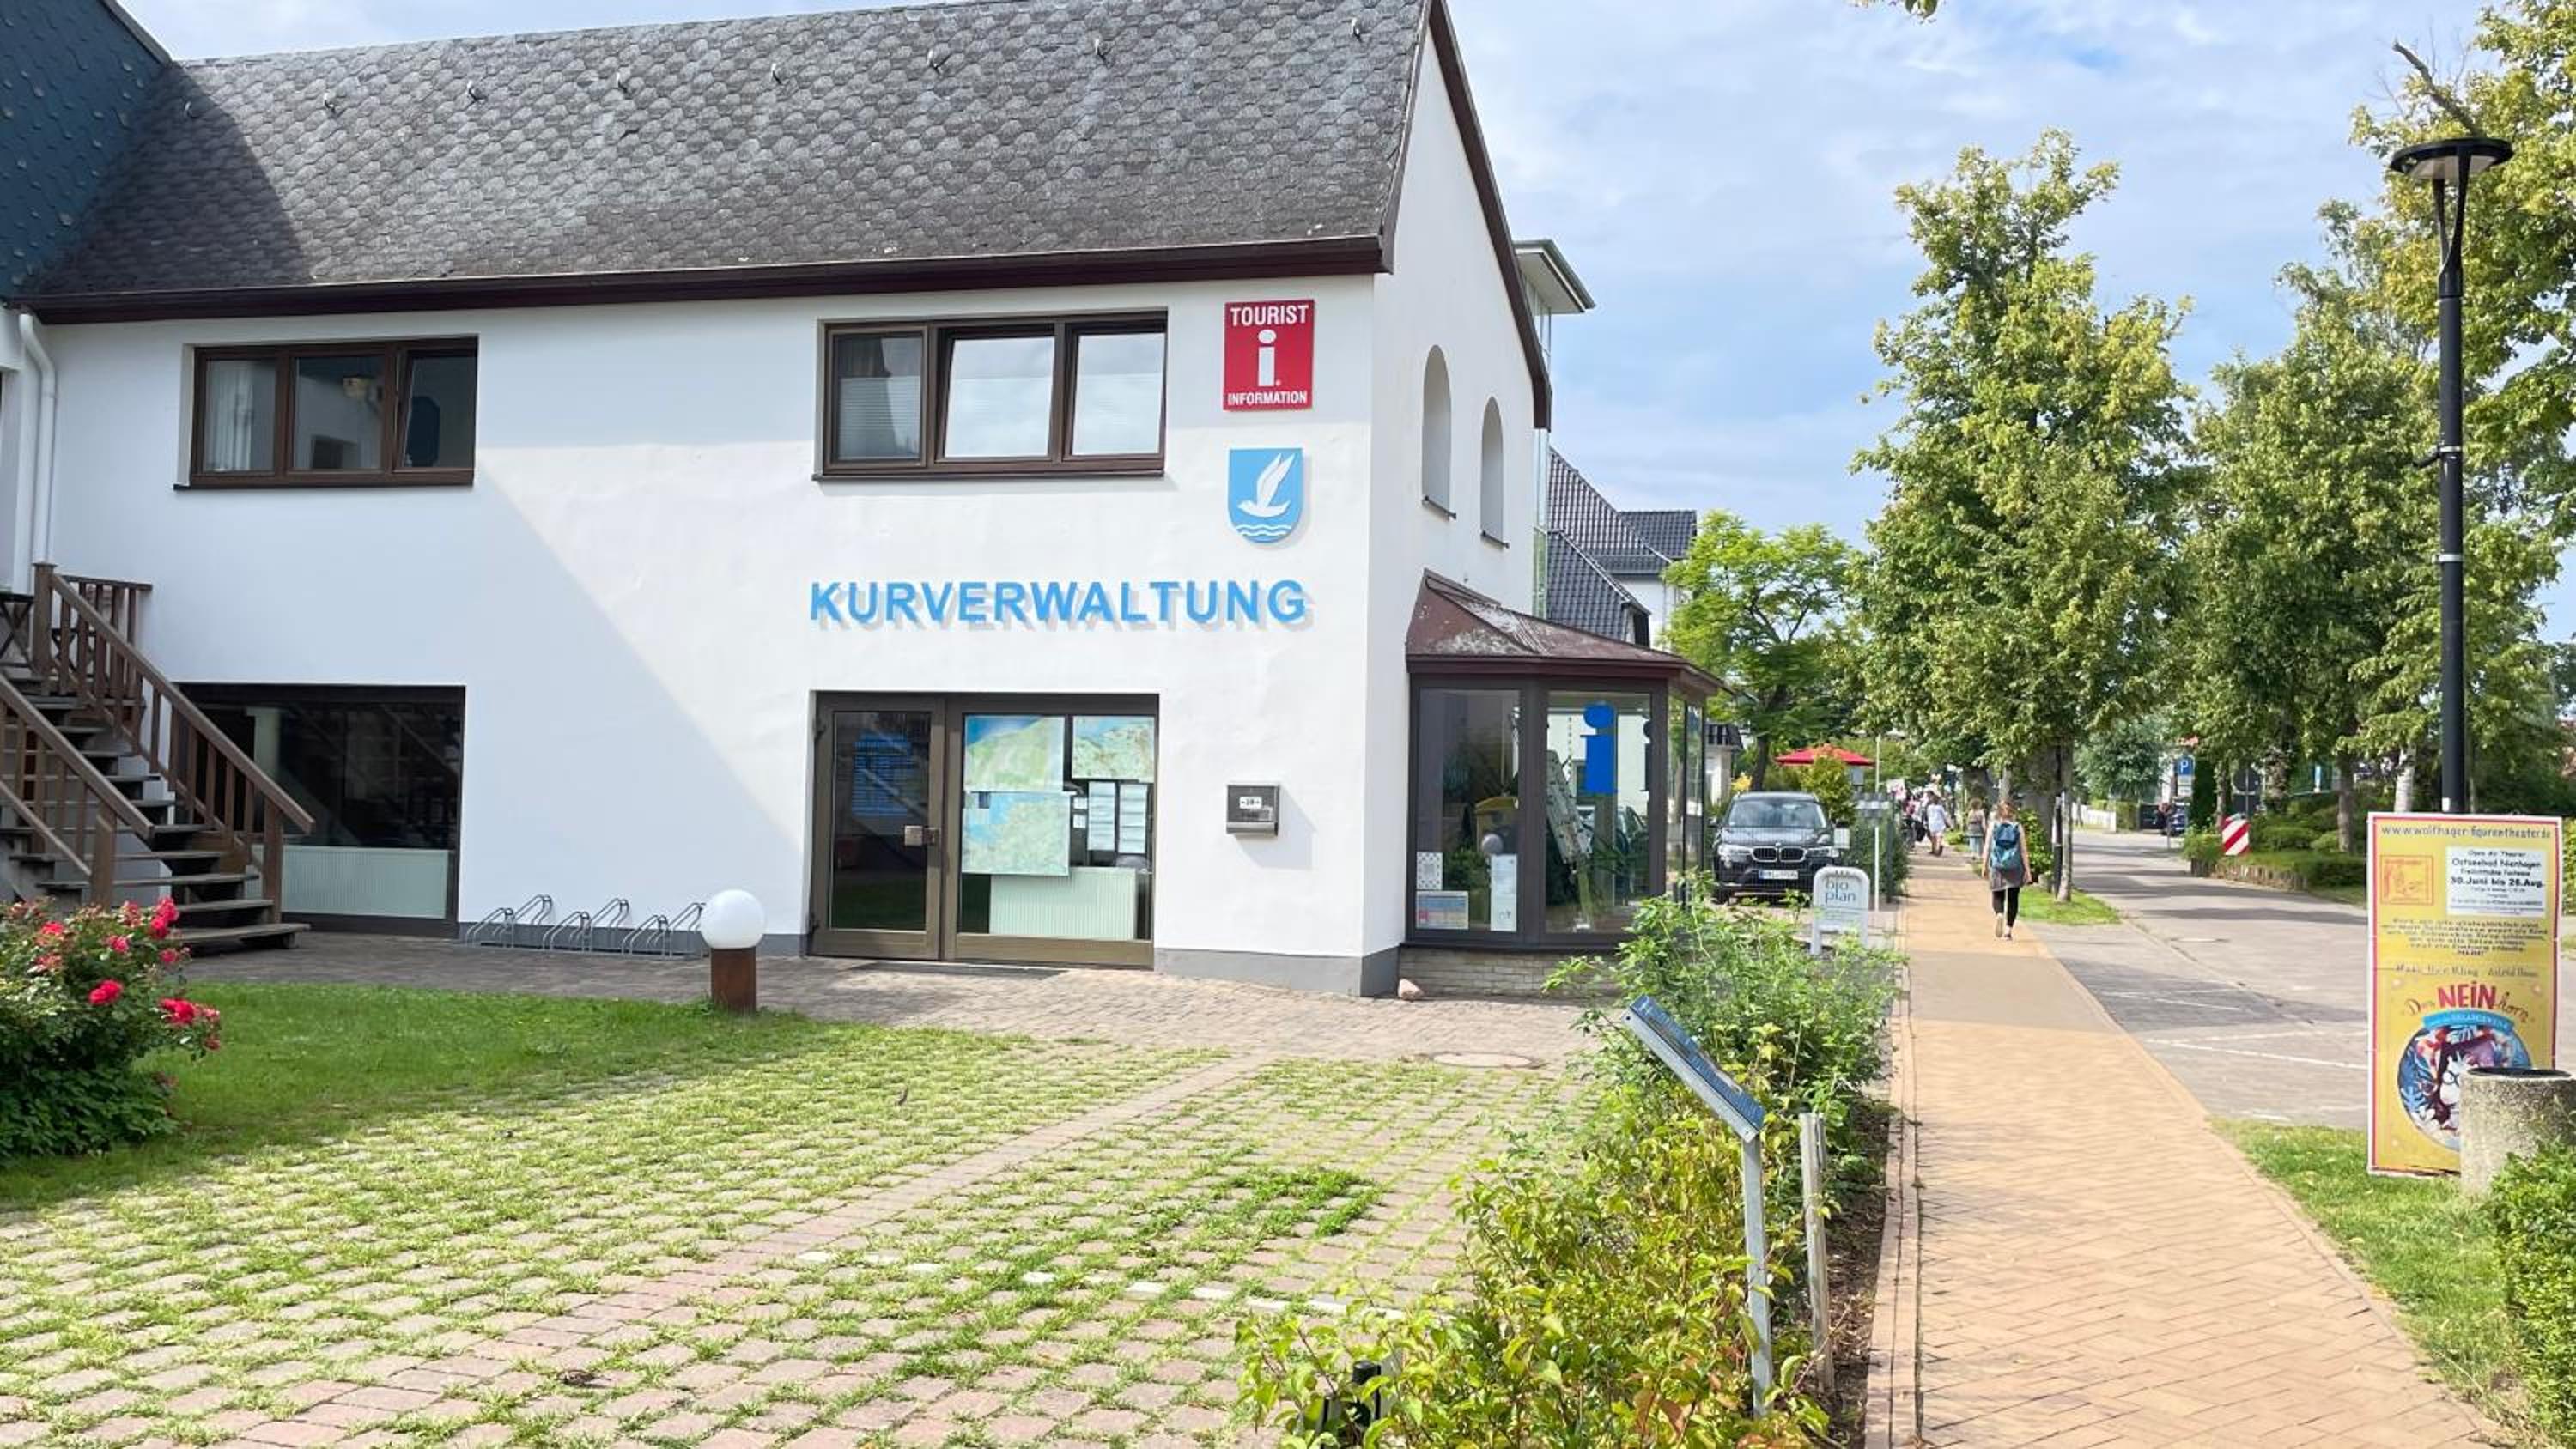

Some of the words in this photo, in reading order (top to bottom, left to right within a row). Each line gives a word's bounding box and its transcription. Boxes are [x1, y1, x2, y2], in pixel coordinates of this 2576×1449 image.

[1230, 305, 1309, 327] TOURIST
[1228, 391, 1307, 405] INFORMATION
[811, 579, 1307, 623] KURVERWALTUNG
[2180, 761, 2189, 773] P
[1825, 876, 1849, 891] bio
[2491, 877, 2506, 886] bis
[1825, 888, 1856, 903] plan
